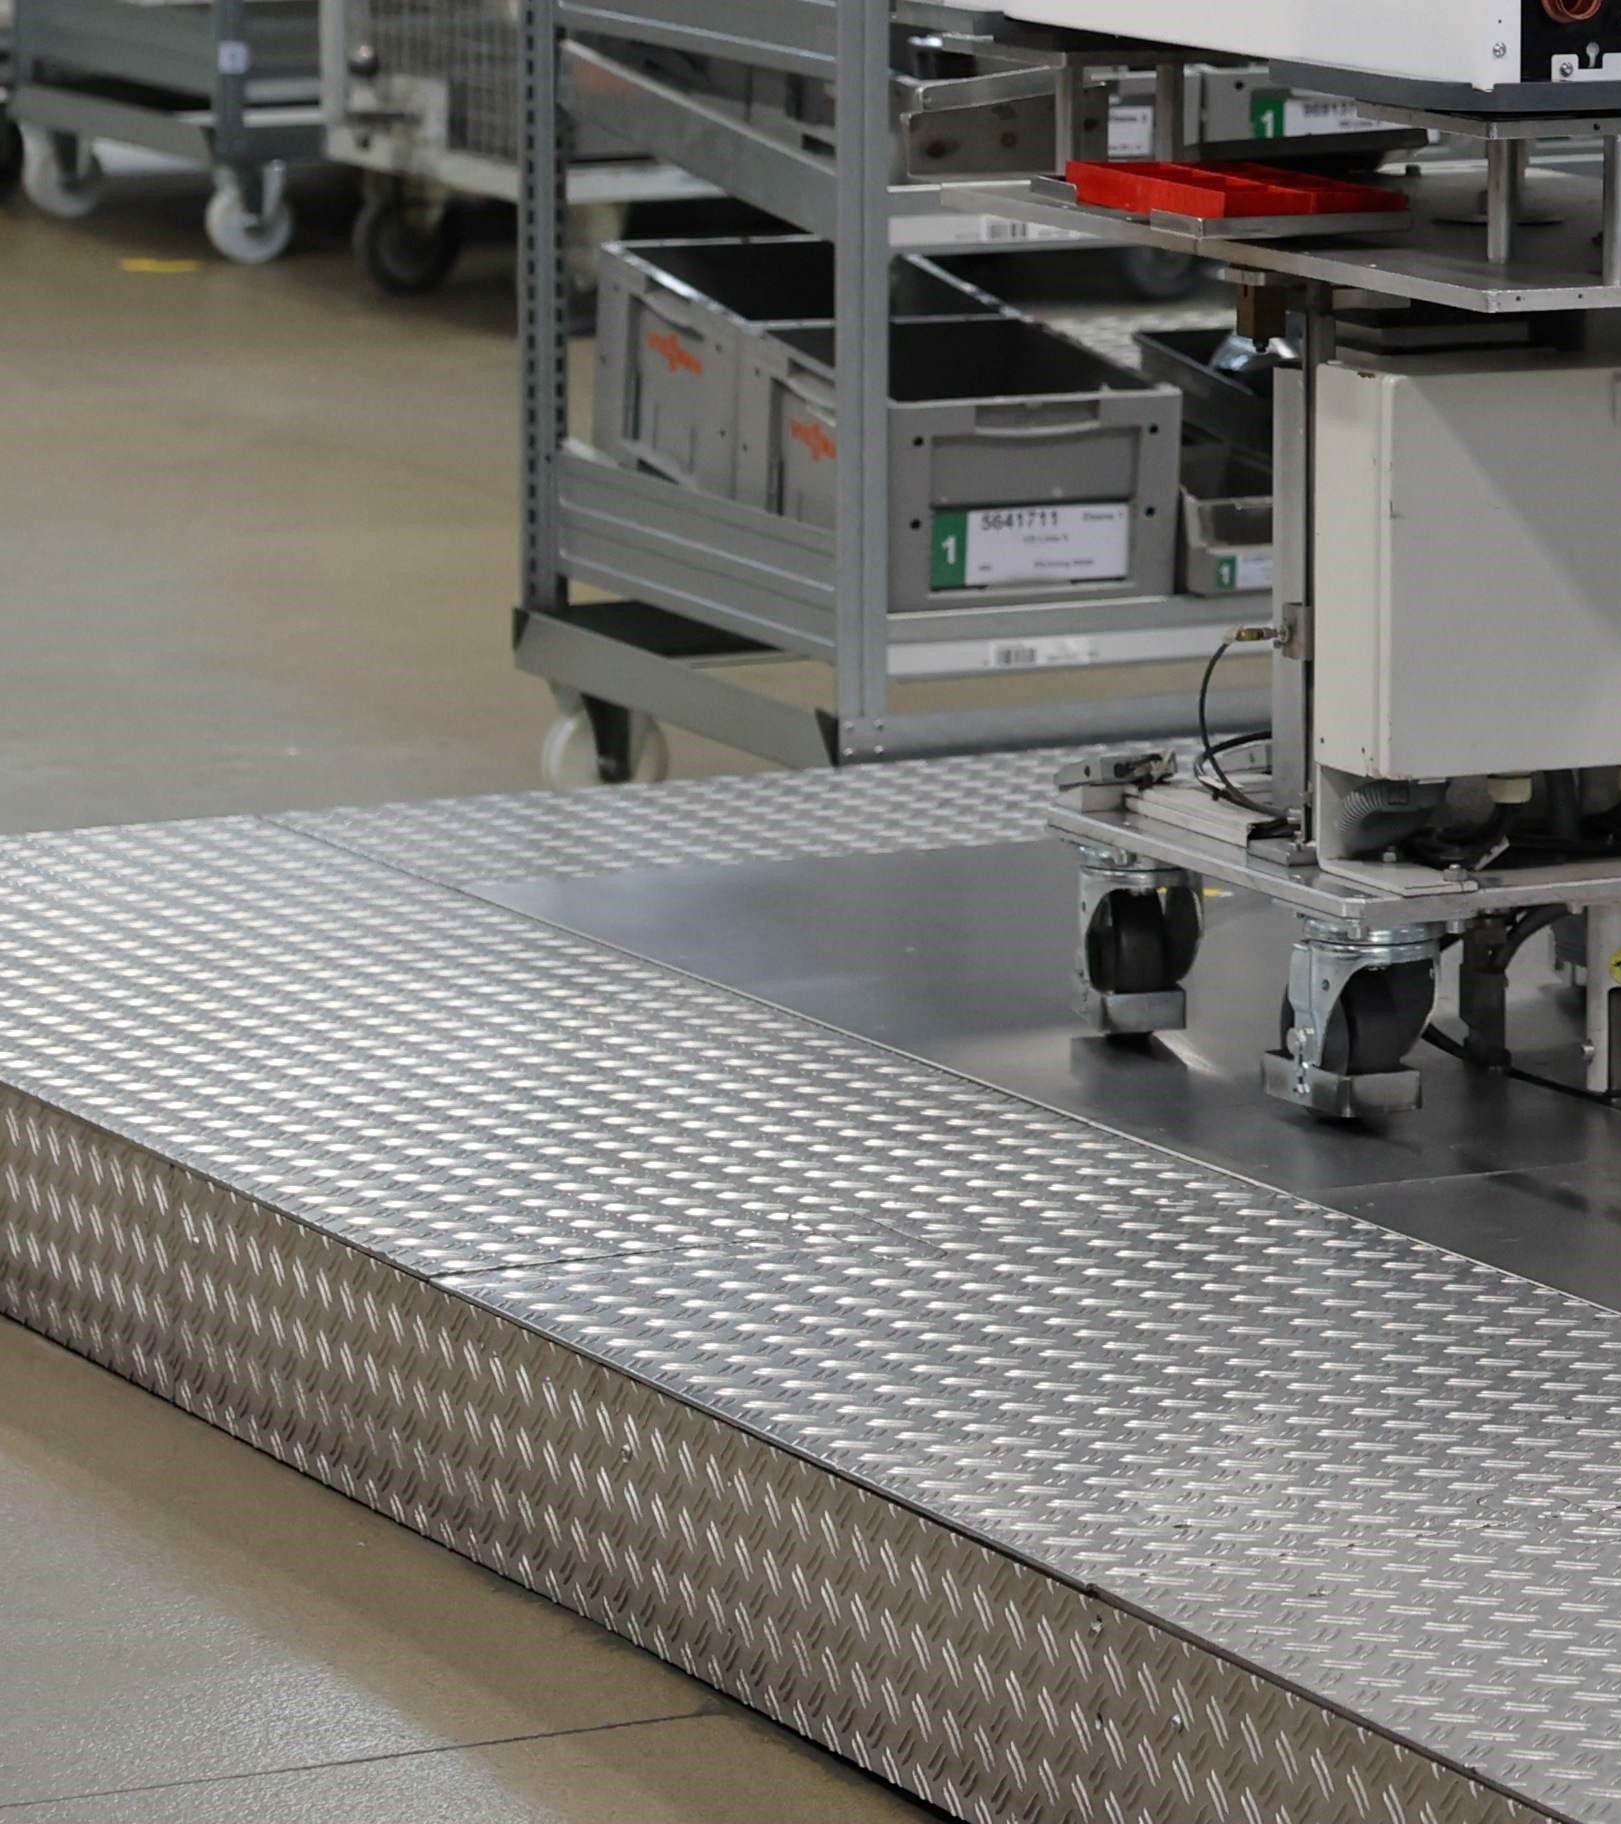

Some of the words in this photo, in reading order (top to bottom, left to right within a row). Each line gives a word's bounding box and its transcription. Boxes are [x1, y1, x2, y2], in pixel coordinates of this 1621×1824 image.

[1260, 109, 1274, 138] 1
[980, 510, 1059, 531] 5641711
[941, 535, 956, 566] 1
